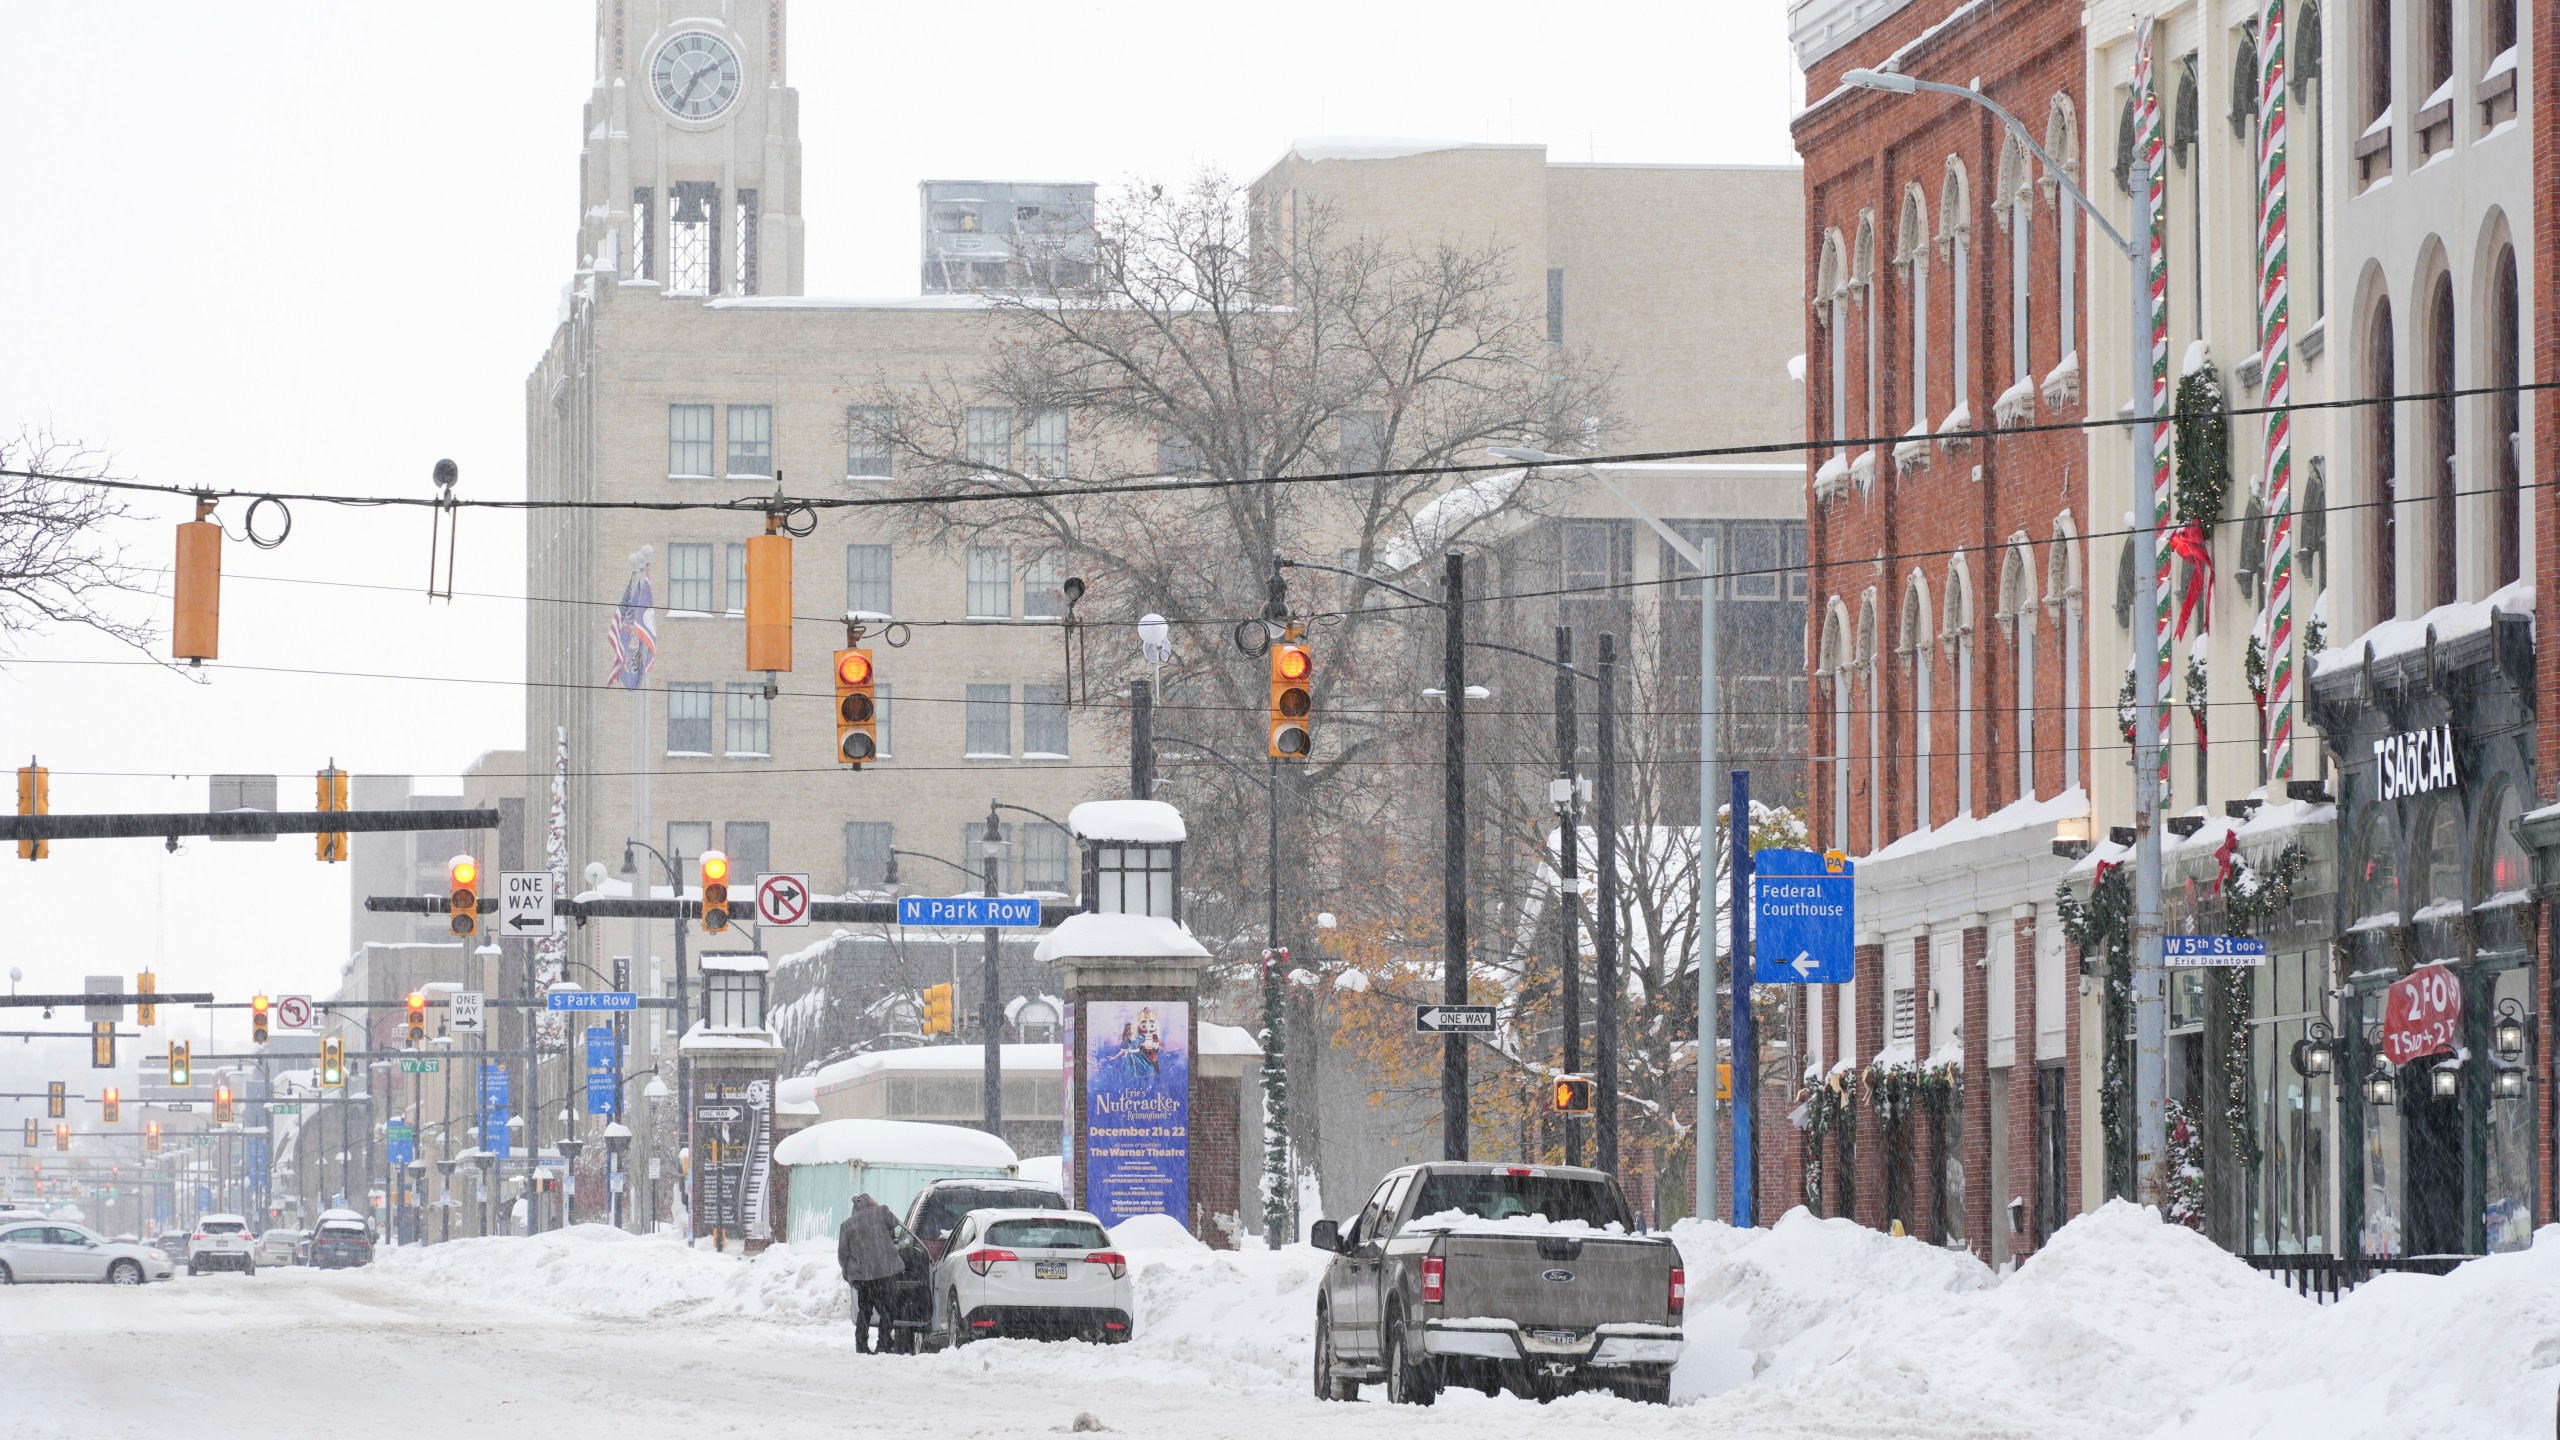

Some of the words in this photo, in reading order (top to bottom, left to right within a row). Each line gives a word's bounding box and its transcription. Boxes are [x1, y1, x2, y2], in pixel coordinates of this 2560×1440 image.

[1827, 858, 1842, 868] PA
[510, 878, 543, 892] ONE
[1762, 884, 1822, 898] Federal
[508, 895, 544, 909] WAY
[907, 902, 920, 918] N
[932, 901, 978, 919] Park
[988, 902, 1032, 919] Row
[1762, 903, 1843, 916] Courthouse
[2166, 938, 2181, 954] W
[2185, 938, 2209, 954] 5th
[2213, 937, 2233, 954] St
[2236, 942, 2256, 952] 000
[2174, 957, 2196, 965] Erie
[2201, 957, 2256, 965] Downtown
[456, 995, 477, 1004] ONE
[554, 995, 562, 1006] S
[567, 995, 597, 1006] Park
[603, 995, 631, 1006] Row
[455, 1006, 478, 1015] WAY
[1440, 1013, 1461, 1024] ONE
[1465, 1013, 1488, 1024] WAY
[402, 1061, 412, 1072] W
[415, 1061, 422, 1072] 7
[425, 1061, 438, 1072] ST
[1125, 1088, 1146, 1098] Erie's
[1096, 1092, 1180, 1115] Nutcracker
[274, 1105, 283, 1114] W
[291, 1105, 300, 1114] ST
[1127, 1111, 1167, 1121] Reimagined
[1089, 1127, 1150, 1137] December
[1151, 1127, 1162, 1137] 21
[1164, 1129, 1170, 1137] &
[1172, 1127, 1185, 1137] 22
[1090, 1148, 1109, 1157] The
[1109, 1148, 1146, 1157] Warner
[1146, 1148, 1185, 1157] Theatre
[1550, 1272, 1568, 1281] Ford
